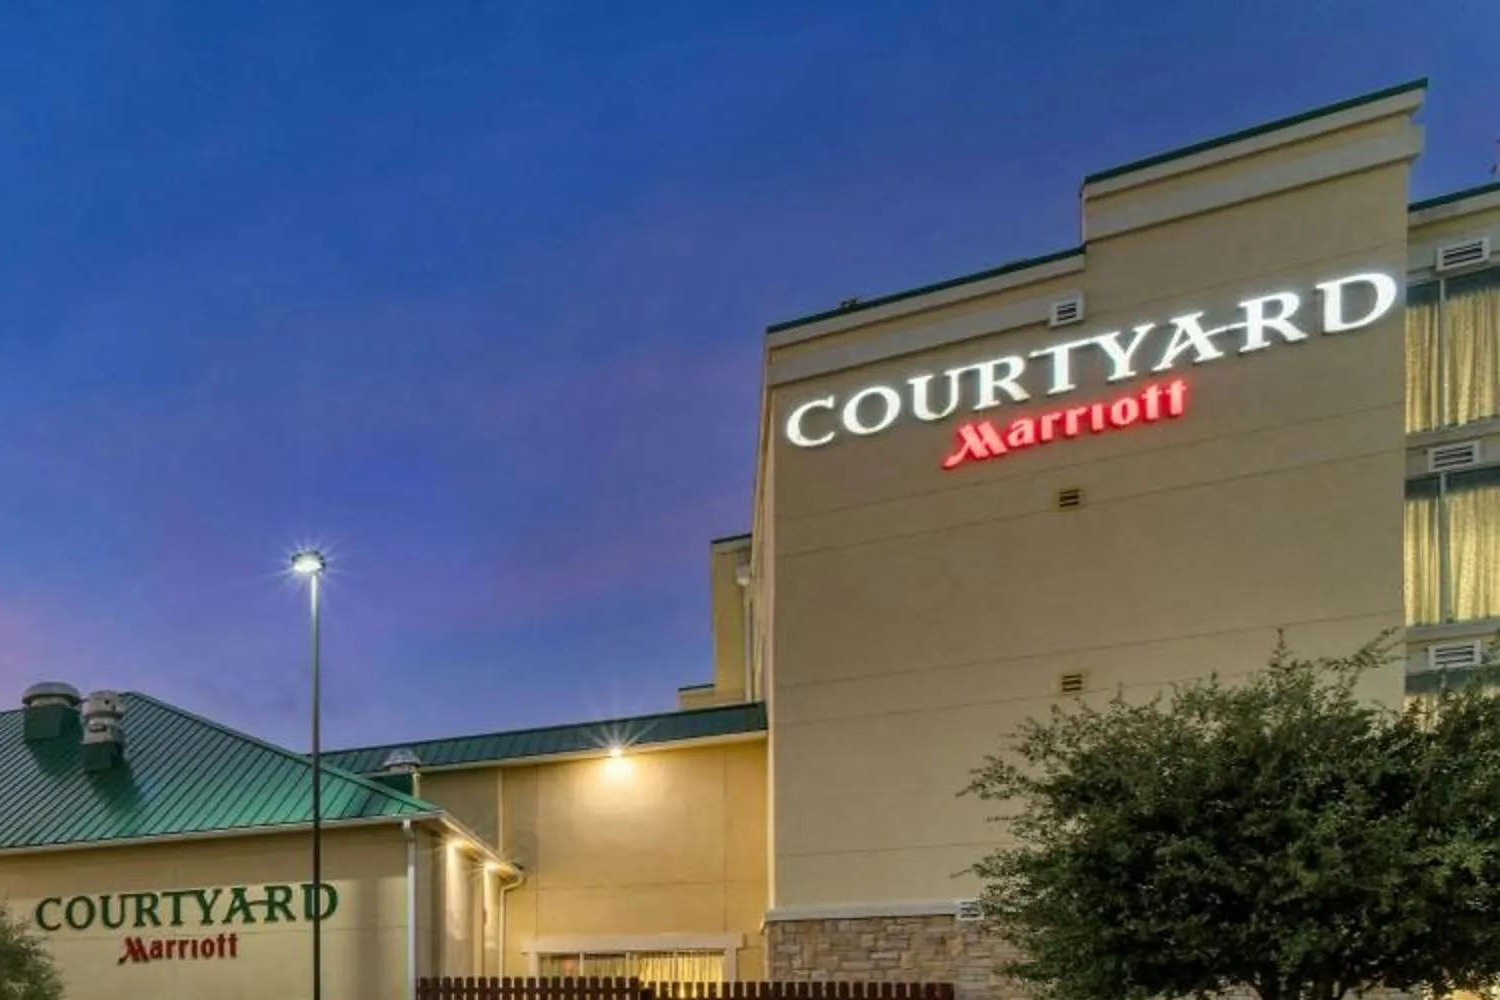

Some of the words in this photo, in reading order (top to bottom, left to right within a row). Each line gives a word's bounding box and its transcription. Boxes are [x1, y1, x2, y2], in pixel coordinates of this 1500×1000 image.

[786, 271, 1400, 449] COURTYARD
[942, 379, 1189, 470] Marriott
[36, 883, 339, 931] COURTYARD
[117, 932, 239, 966] Marriott
